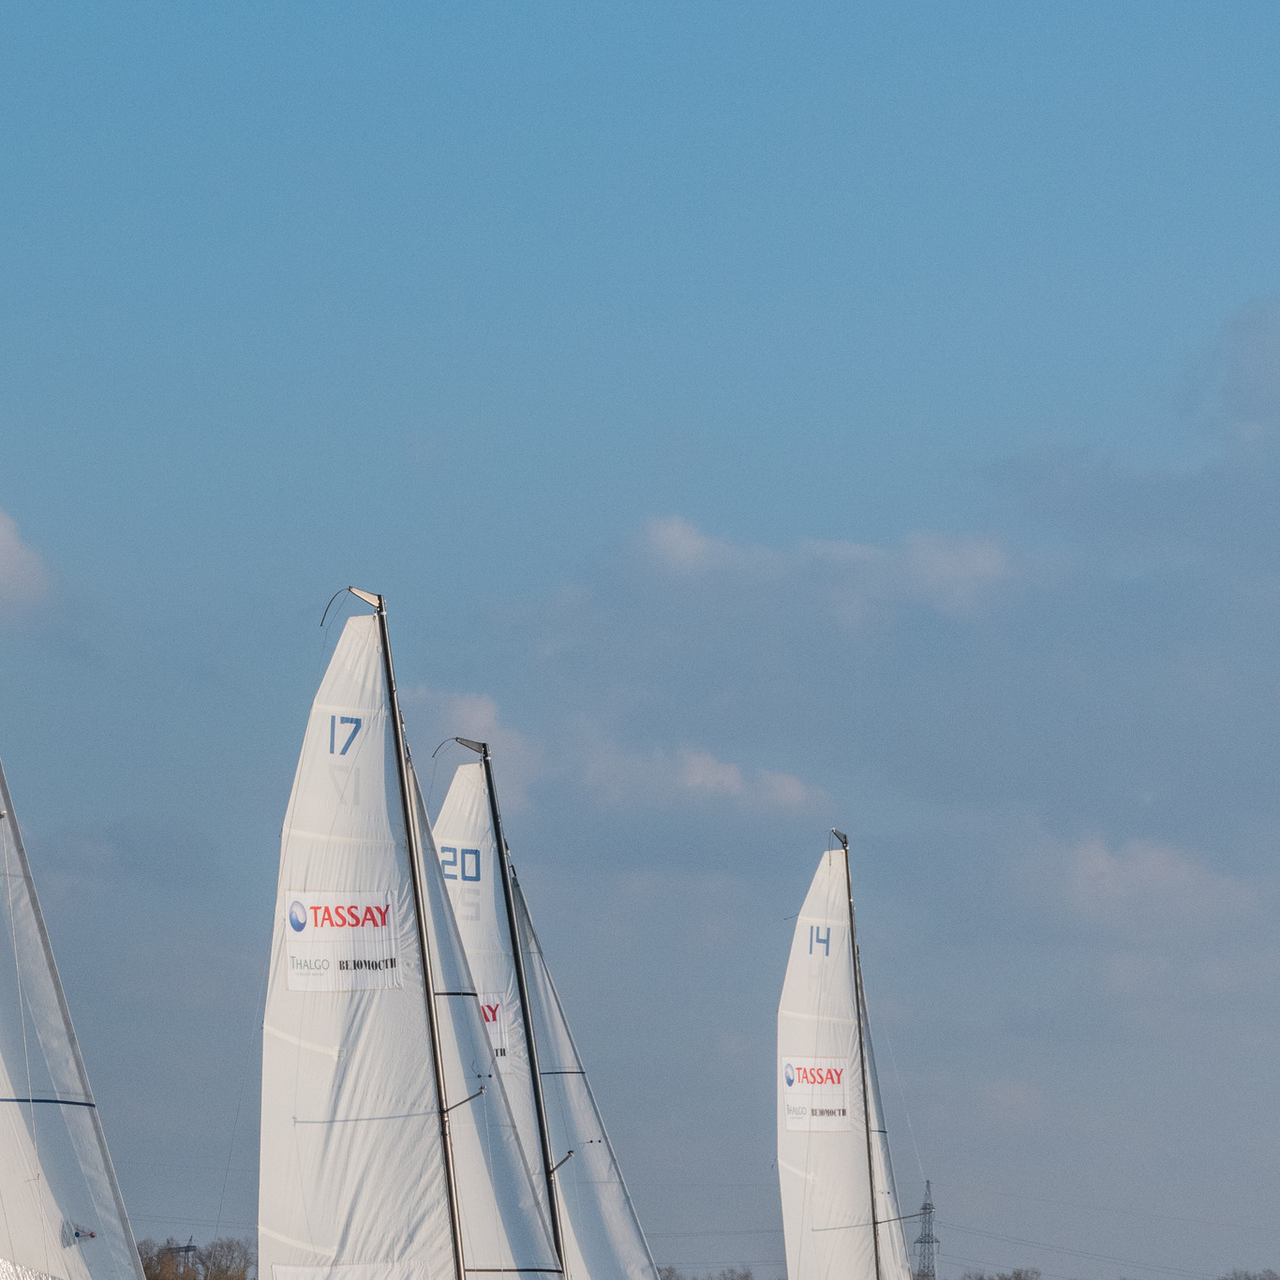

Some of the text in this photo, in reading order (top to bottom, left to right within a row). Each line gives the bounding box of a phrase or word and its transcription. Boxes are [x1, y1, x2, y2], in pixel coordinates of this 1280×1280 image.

[329, 714, 362, 756] 17
[440, 846, 481, 882] 20
[309, 903, 391, 929] TASSAY
[808, 925, 831, 957] 14
[290, 956, 330, 971] THALGO
[795, 1067, 844, 1085] TASSAY
